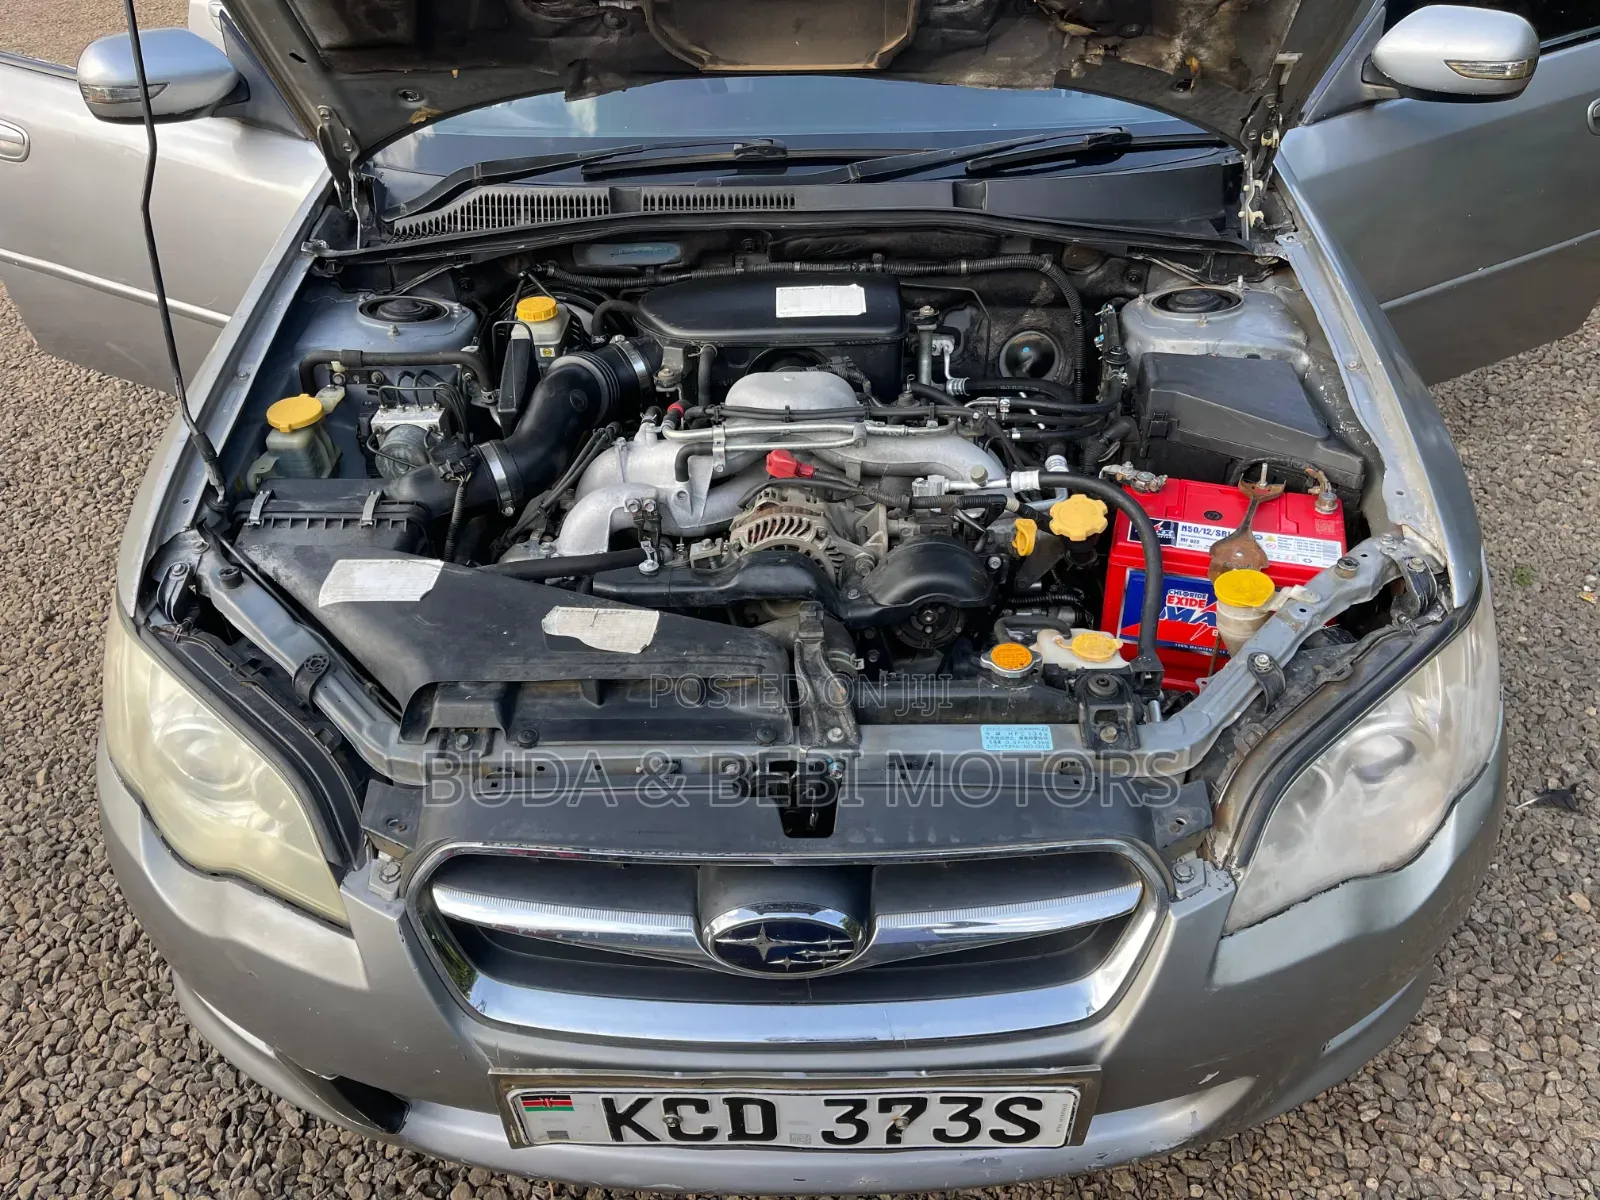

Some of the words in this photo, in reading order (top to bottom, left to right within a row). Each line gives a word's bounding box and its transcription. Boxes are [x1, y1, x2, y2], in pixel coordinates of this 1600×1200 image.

[1166, 595, 1207, 609] EXIDE
[1168, 589, 1208, 600] CHLORIDE
[1159, 606, 1218, 628] MA
[600, 1096, 779, 1143] KCD
[820, 1095, 1045, 1145] 373S
